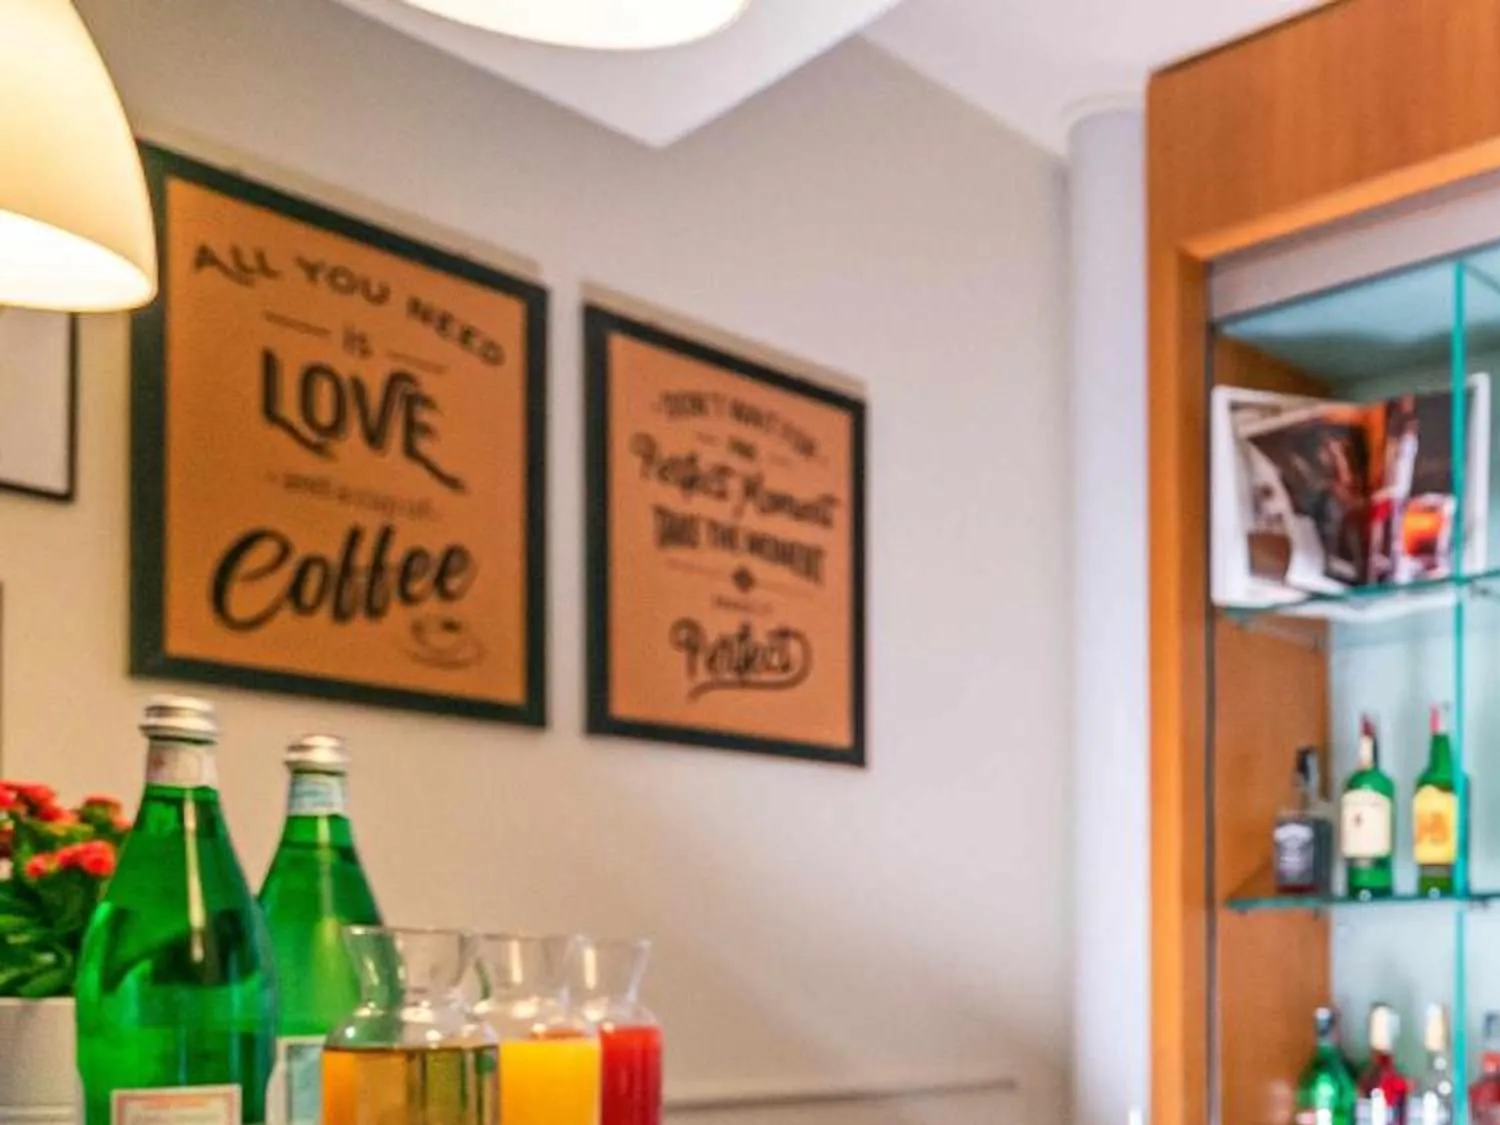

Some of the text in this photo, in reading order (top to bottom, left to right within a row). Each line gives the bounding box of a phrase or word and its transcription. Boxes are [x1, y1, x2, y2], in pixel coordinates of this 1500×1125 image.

[194, 243, 506, 368] ALL YOU NEED
[260, 346, 467, 494] LOVE
[210, 524, 478, 633] Coffee
